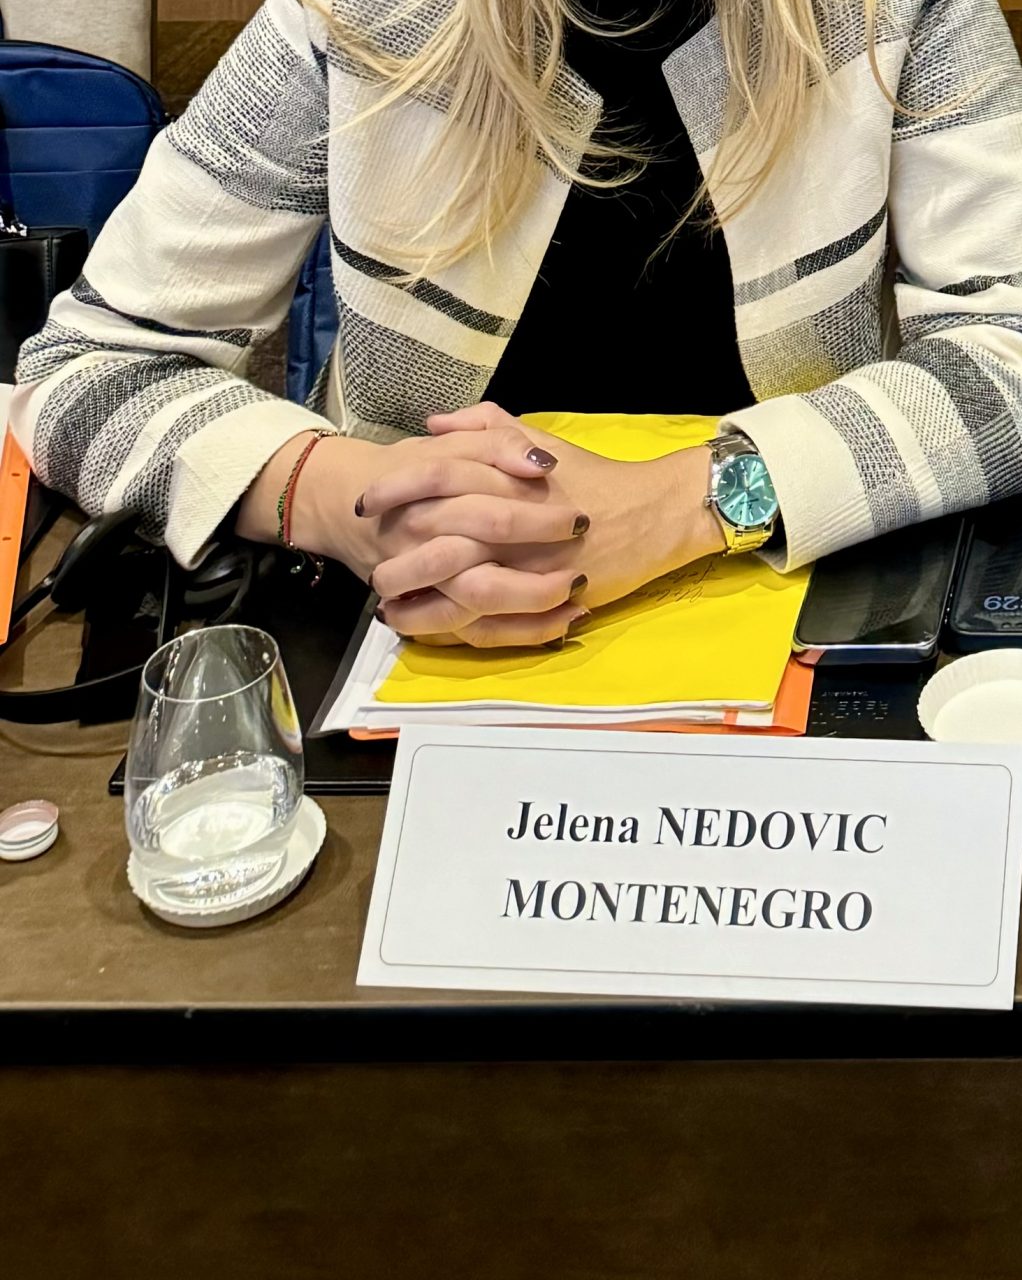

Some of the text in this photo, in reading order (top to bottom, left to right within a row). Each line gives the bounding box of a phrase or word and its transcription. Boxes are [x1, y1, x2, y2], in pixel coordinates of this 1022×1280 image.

[506, 801, 888, 854] Jelena NEDOVIC
[502, 878, 873, 932] MONTENEGRO
